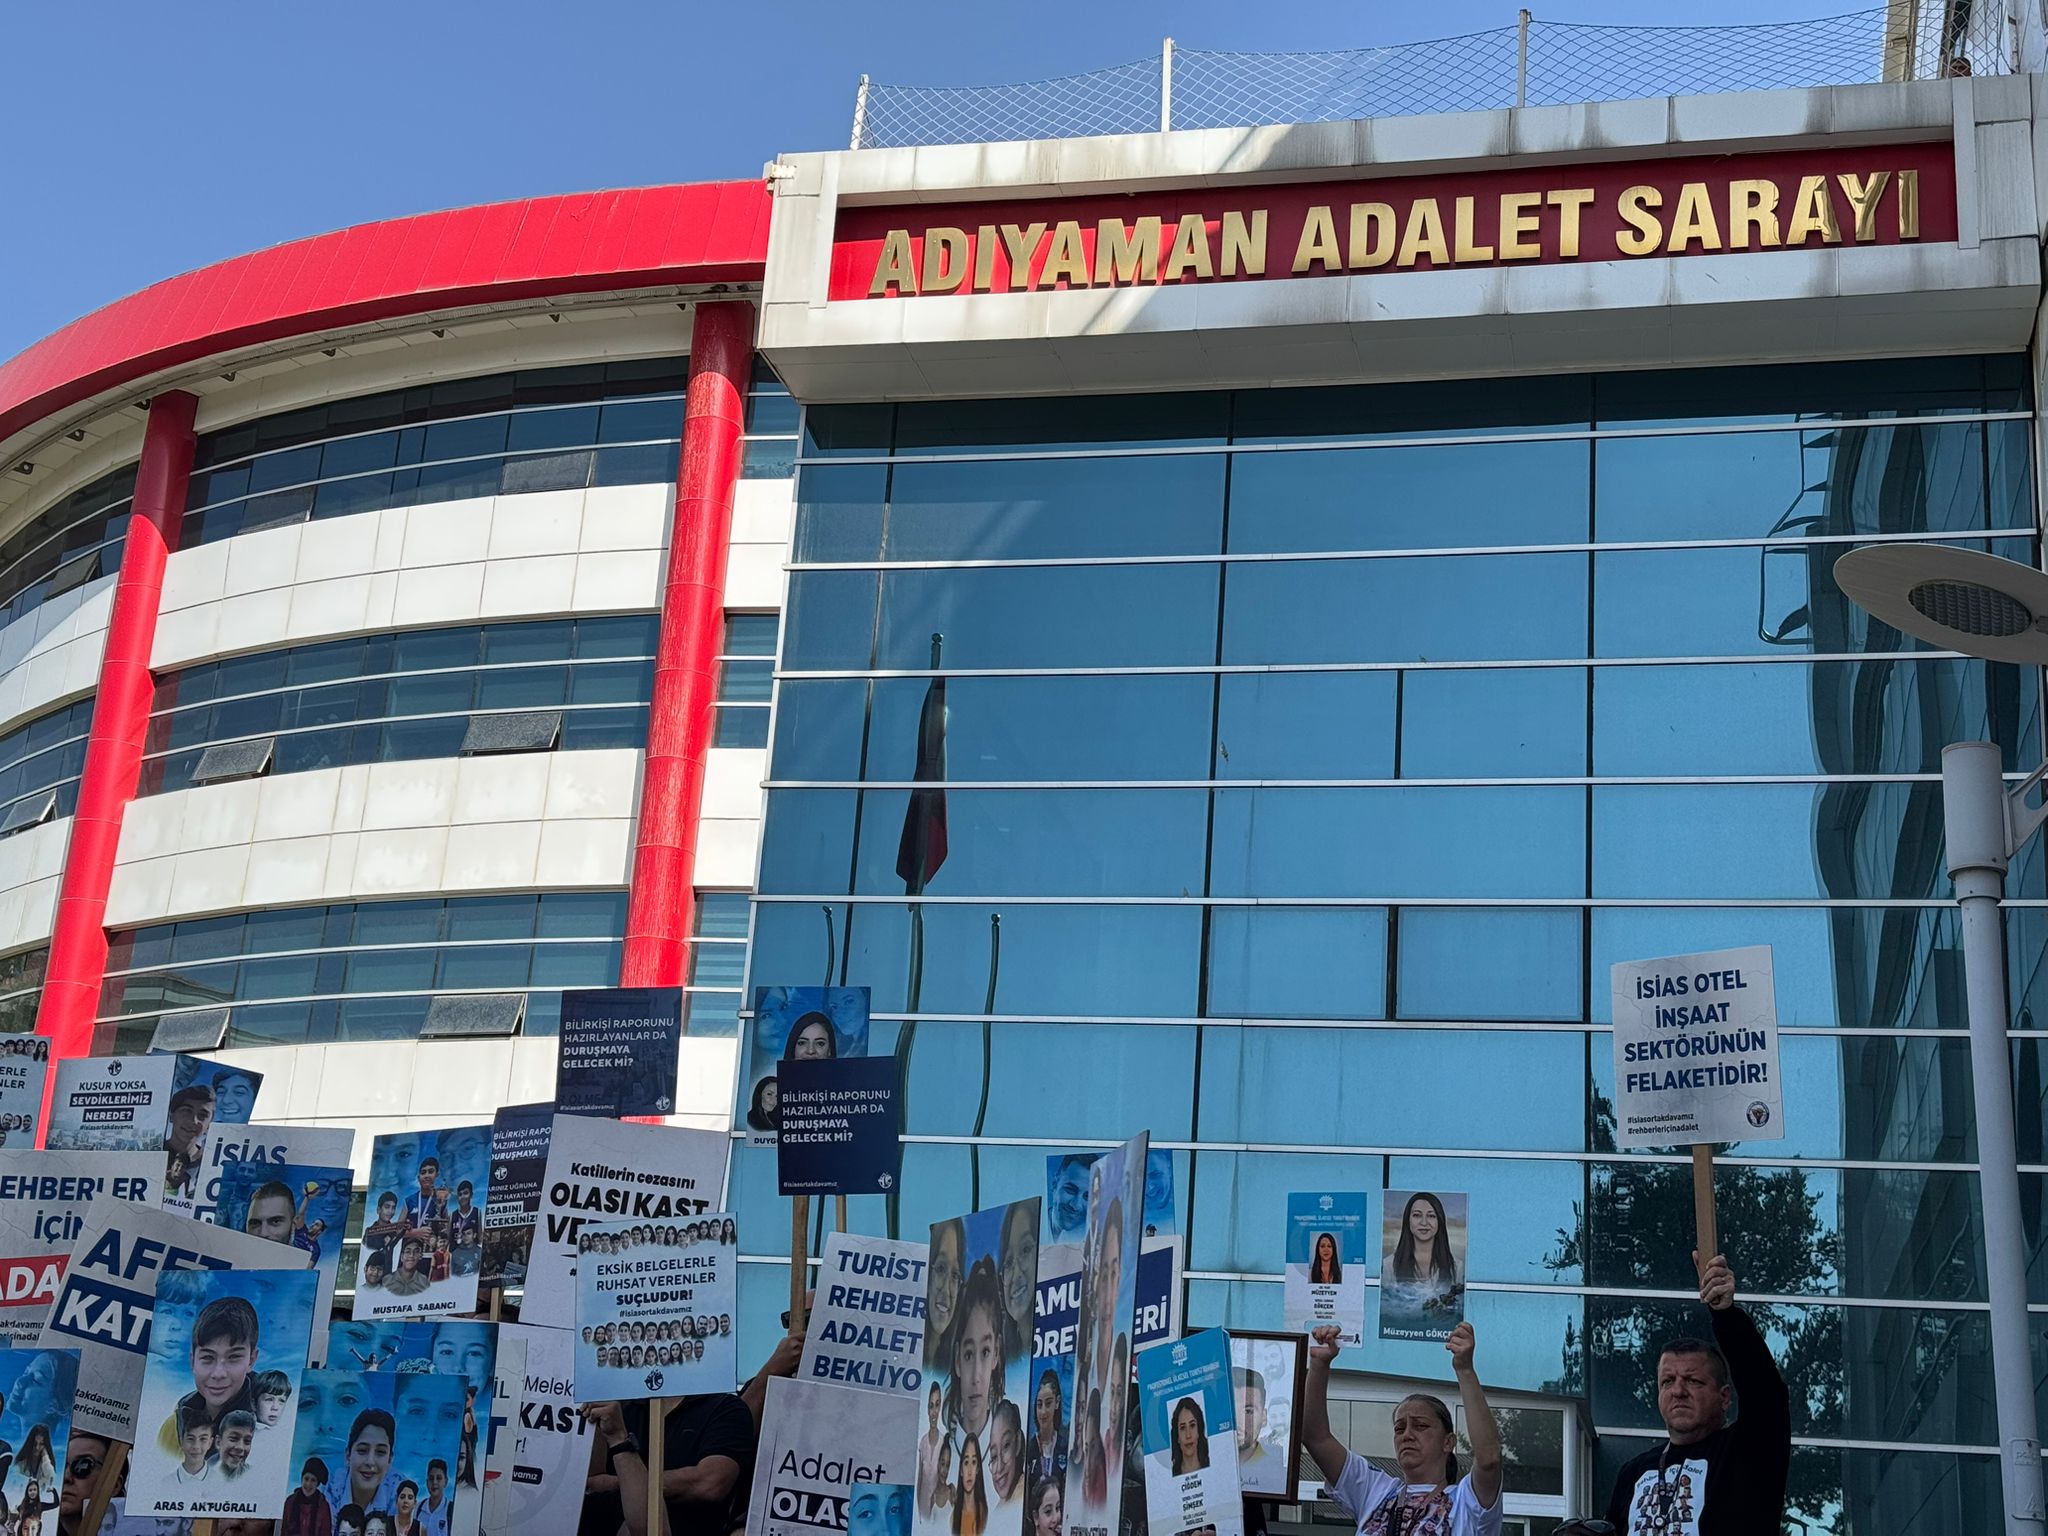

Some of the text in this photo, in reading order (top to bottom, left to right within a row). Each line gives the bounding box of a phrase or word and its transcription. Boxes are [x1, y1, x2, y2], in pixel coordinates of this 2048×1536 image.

[868, 169, 1919, 294] ADIYAMAN ADALET SARAYI
[1636, 969, 1747, 999] İSİAS OTEL
[1655, 1002, 1730, 1029] İNŞAAT
[565, 1017, 675, 1031] BİLİRKİŞİ RAPORUNU
[564, 1030, 667, 1042] HAZIRLAYANLAR DA
[563, 1045, 630, 1057] DURUŞMAYA
[1624, 1028, 1766, 1062] SEKTÖRÜNÜN
[562, 1056, 634, 1069] GELECEK Mİ?
[1626, 1060, 1768, 1093] FELAKETİDİR!
[79, 1080, 147, 1091] KUSUR YOKSA
[72, 1093, 150, 1106] SEVDİKLERİMİZ
[782, 1089, 891, 1103] BİLİRKİŞİ RAPORUNU
[85, 1111, 132, 1121] NEREDE?
[782, 1103, 885, 1116] HAZIRLAYANLAR DA
[782, 1118, 849, 1131] DURUŞMAYA
[782, 1130, 853, 1143] GELECEK Mİ?
[570, 1162, 696, 1190] Katillerin cezasını
[550, 1182, 631, 1214] OLASI
[597, 1256, 716, 1276] EKSİK BELGELERLE
[838, 1250, 926, 1283] TURİST
[596, 1272, 716, 1291] RUHSAT VERENLER
[615, 1290, 693, 1307] SUÇLUDUR!
[372, 1301, 456, 1315] MUSTAFA SABANCI
[819, 1320, 923, 1355] ADALET
[1383, 1327, 1424, 1338] Müzeyyen
[778, 1448, 886, 1486] Adalet
[154, 1501, 257, 1513] ARAS AKTUĞRALI
